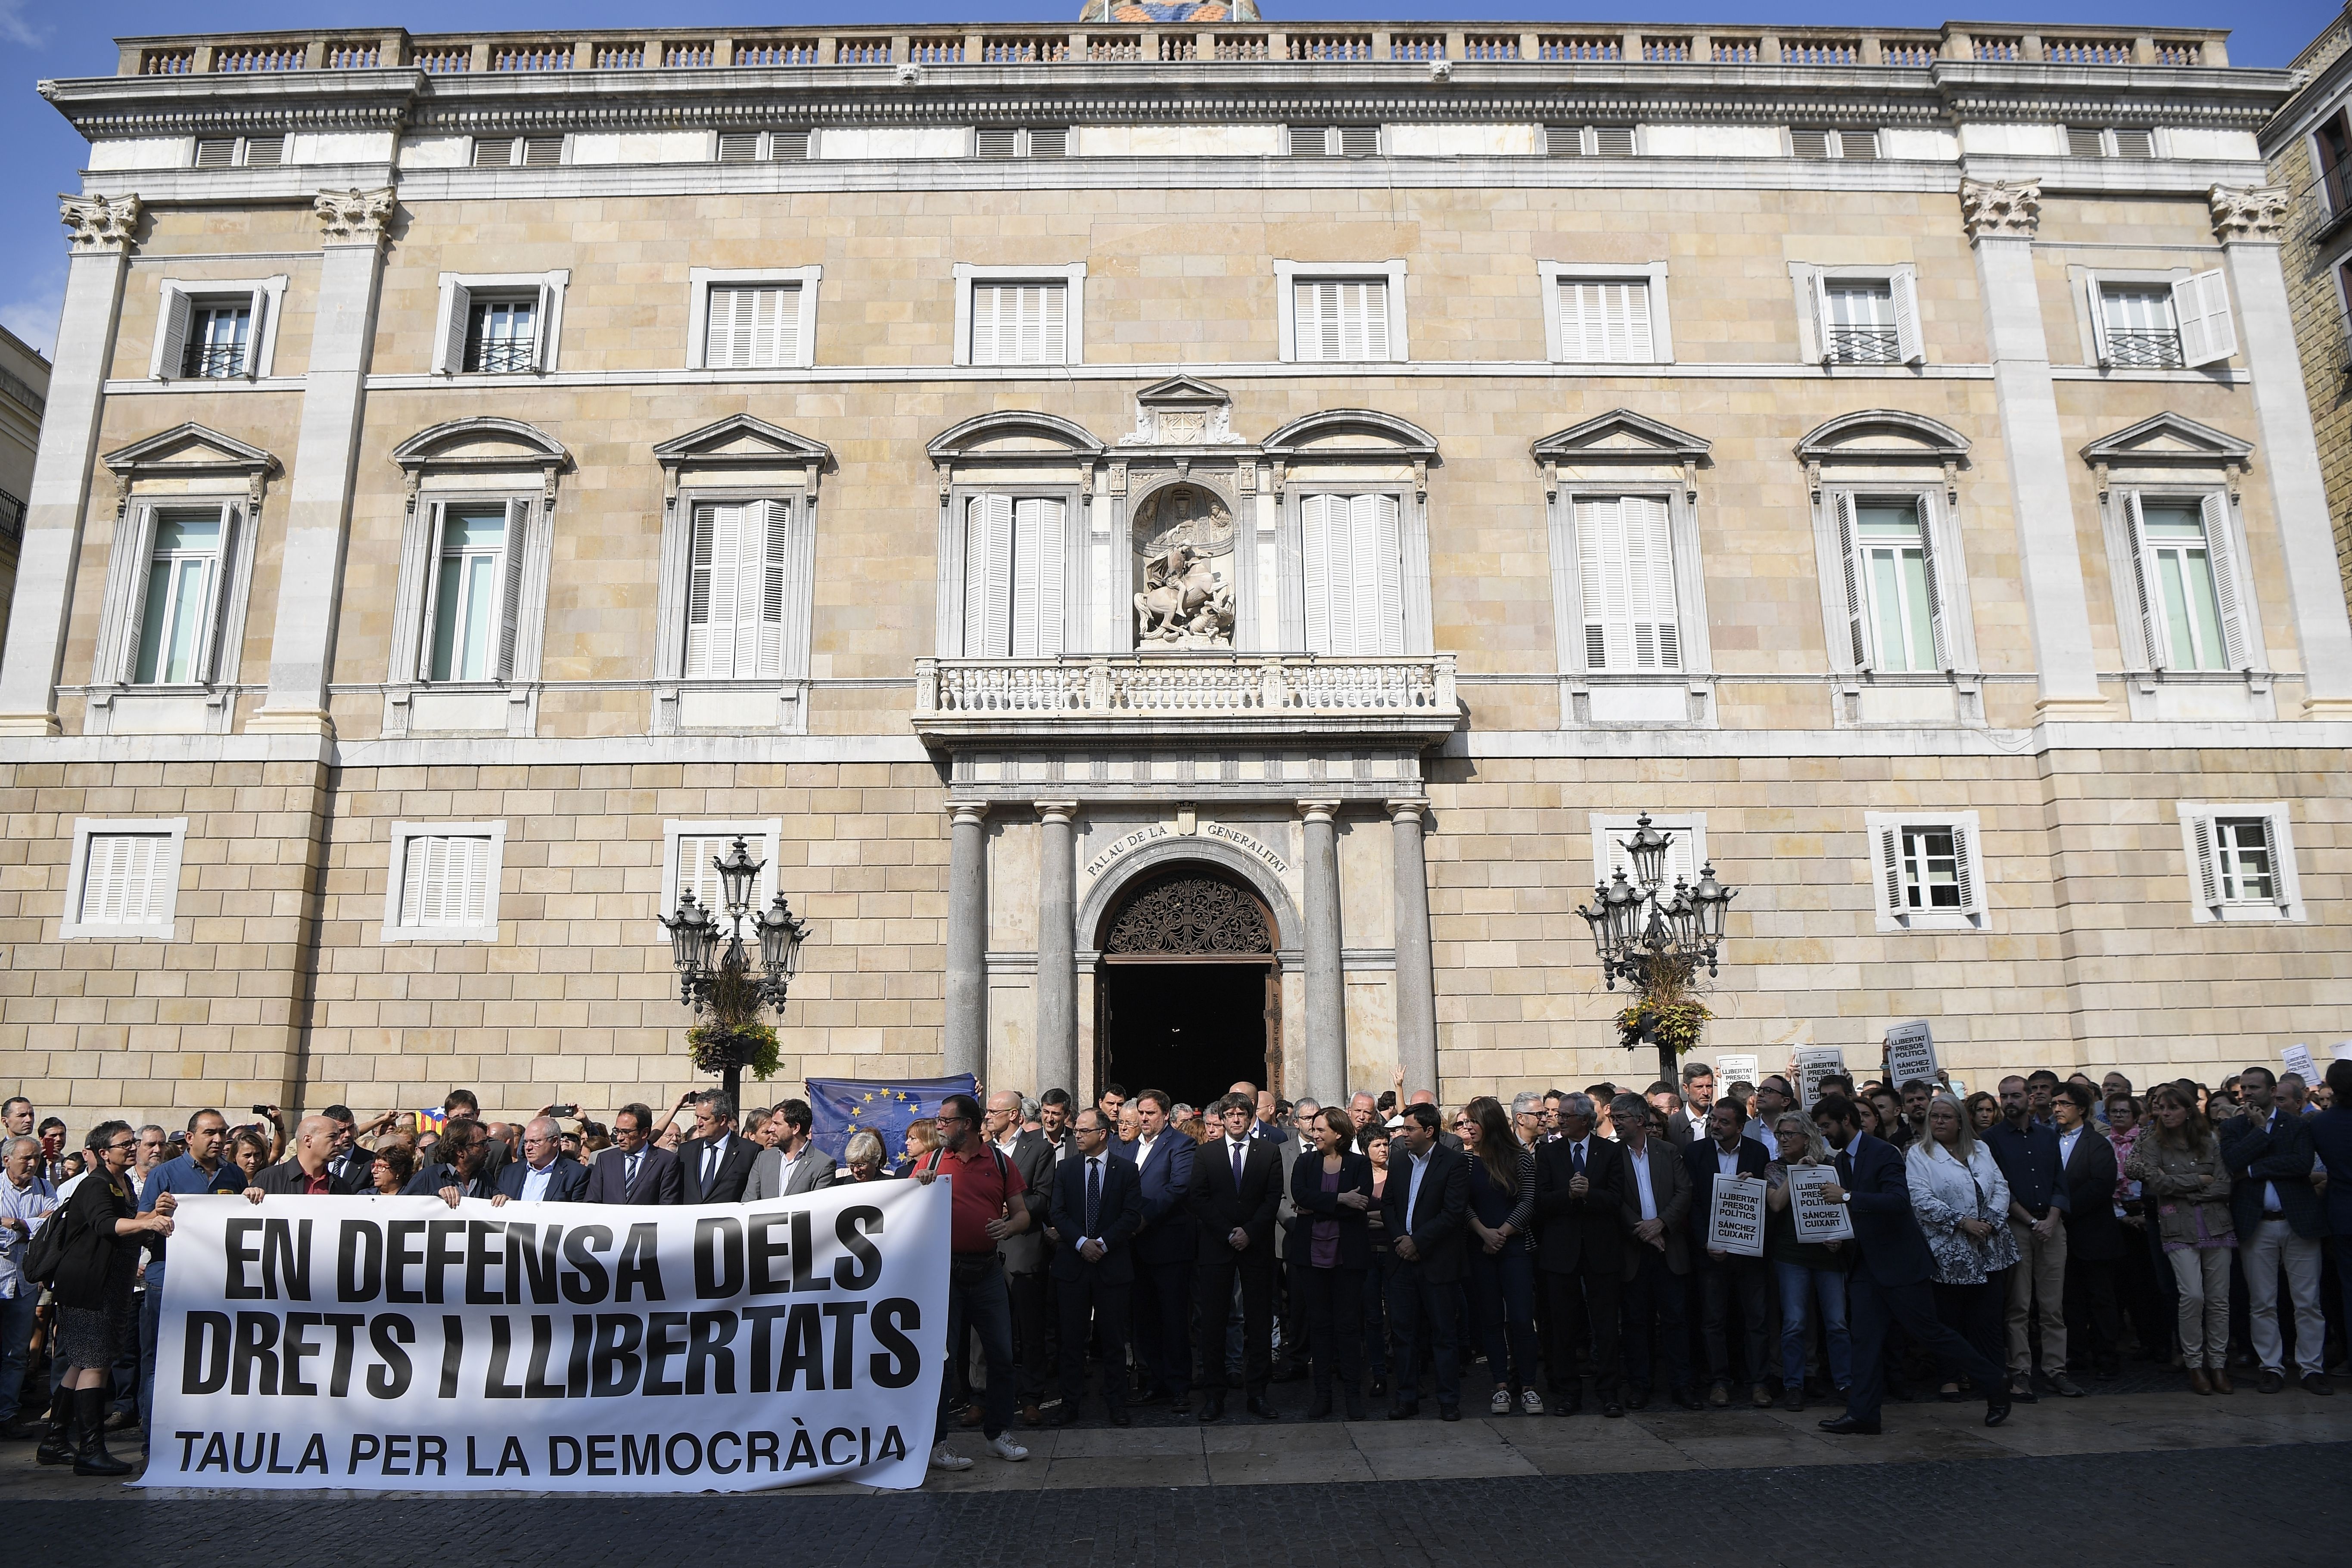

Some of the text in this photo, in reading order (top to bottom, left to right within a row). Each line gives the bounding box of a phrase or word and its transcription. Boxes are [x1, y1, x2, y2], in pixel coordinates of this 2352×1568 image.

[1087, 825, 1288, 876] PALAU DE LA GENERALITAT
[1891, 1035, 1926, 1045] LLIBERTAT
[1895, 1042, 1924, 1052] PRESOS
[1895, 1049, 1927, 1059] POLÍTICS
[1897, 1059, 1930, 1069] SÁNCHEZ
[1899, 1066, 1930, 1076] CUIXART
[1719, 1192, 1759, 1204] LLIBERTAT
[1722, 1201, 1755, 1212] PRESOS
[1719, 1209, 1756, 1220] POLÍTICS
[1802, 1211, 1840, 1220] SÁNCHEZ
[1718, 1220, 1756, 1233] SÁNCHEZ
[1805, 1220, 1840, 1228] CUIXART
[1718, 1229, 1755, 1241] CUIXART
[225, 1205, 884, 1305] EN DEFENSA DELS
[182, 1297, 921, 1400] DRETS I LLIBERTATS
[175, 1416, 906, 1476] TAULA PER LA DEMOCRÀCIA
